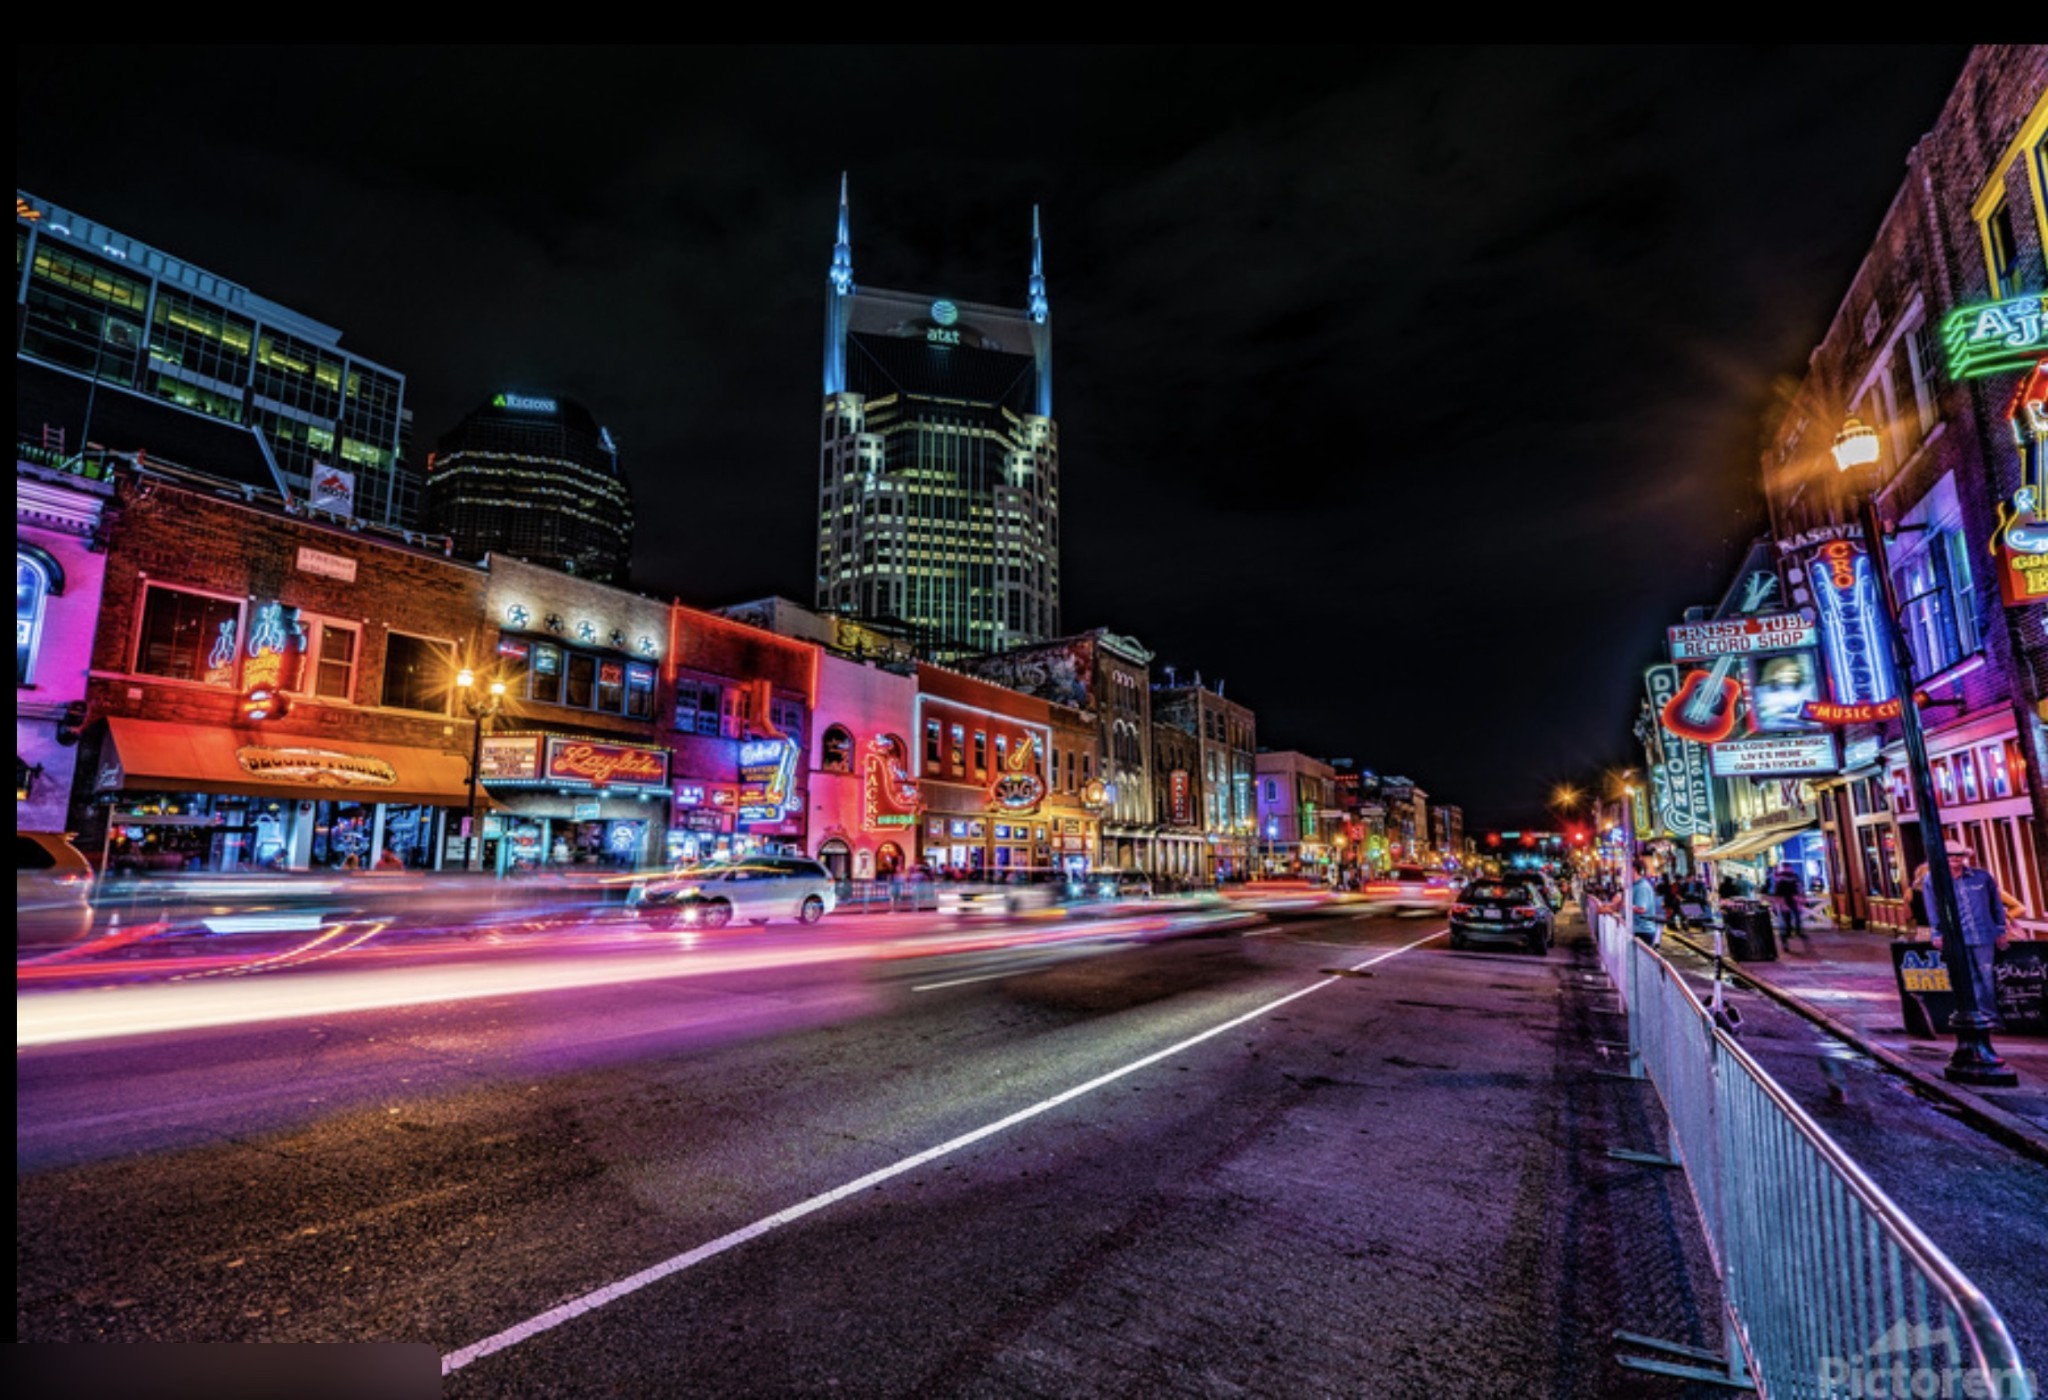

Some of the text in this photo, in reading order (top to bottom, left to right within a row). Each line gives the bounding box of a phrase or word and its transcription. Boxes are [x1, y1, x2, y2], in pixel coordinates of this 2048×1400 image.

[1674, 619, 1748, 641] ERNEST
[1684, 631, 1803, 656] RECORD SHOP
[1904, 976, 1952, 991] BAR
